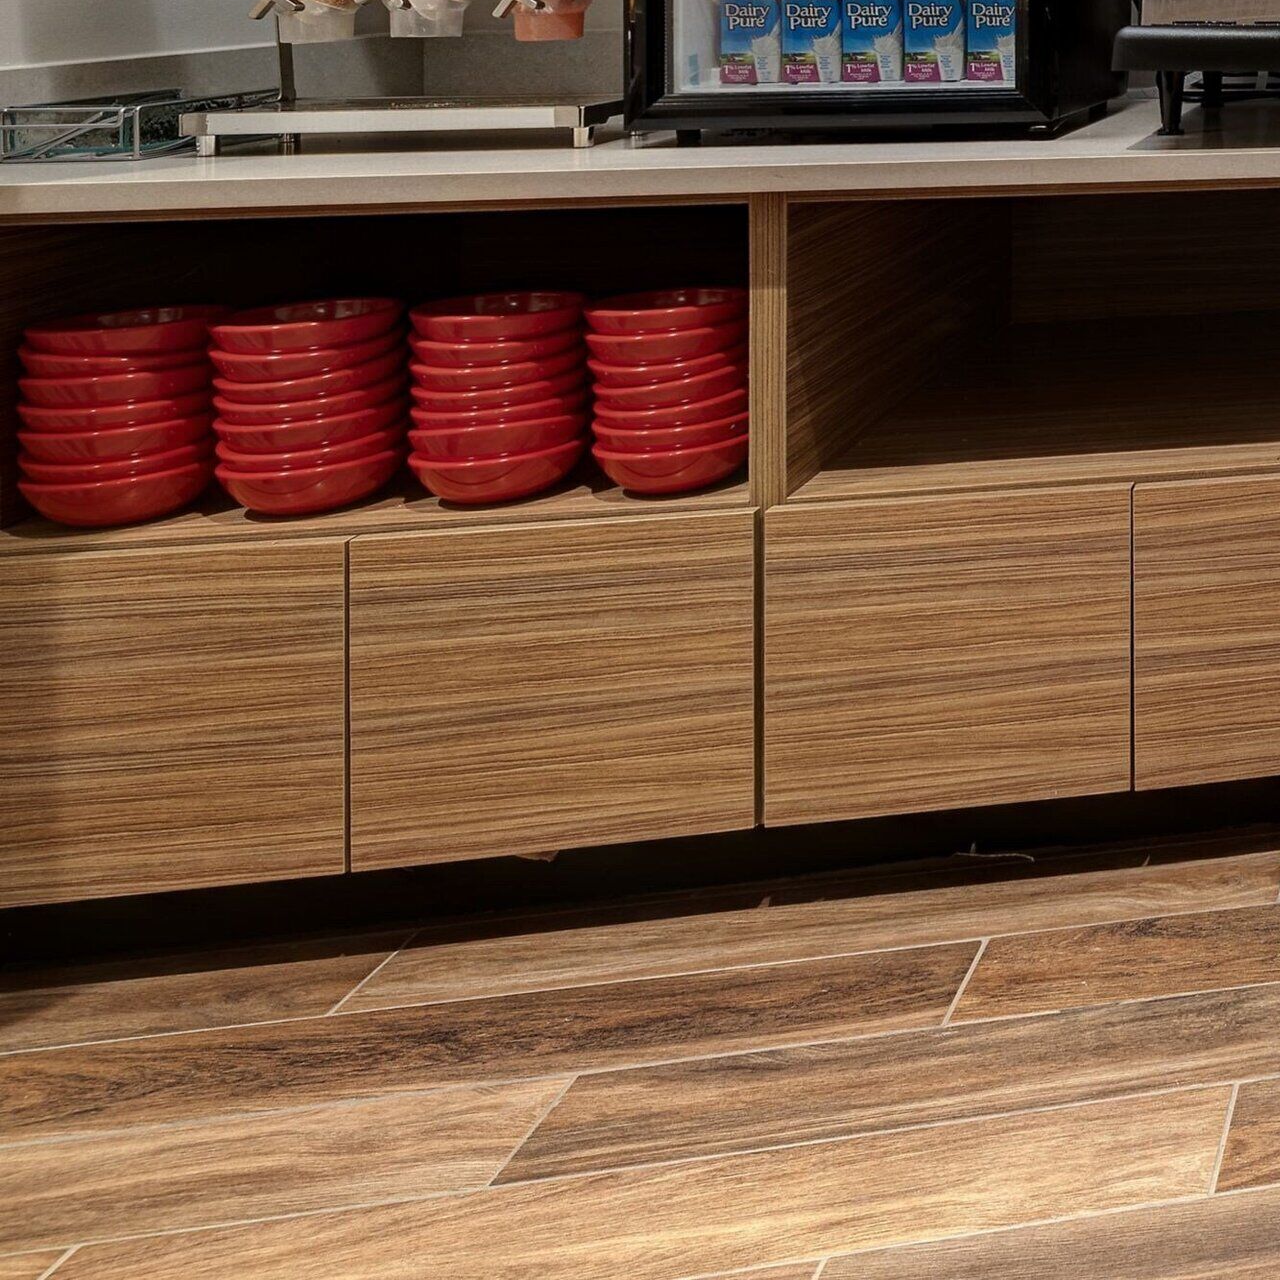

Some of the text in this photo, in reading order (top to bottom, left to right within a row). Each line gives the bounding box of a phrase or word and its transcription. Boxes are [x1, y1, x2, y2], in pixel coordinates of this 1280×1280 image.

[725, 3, 770, 17] Dairy
[786, 3, 831, 18] Dairy
[847, 3, 892, 17] Dairy
[908, 3, 952, 17] Dairy
[972, 3, 1015, 17] Dairy
[729, 17, 765, 29] Pure
[790, 17, 827, 29] Pure
[851, 16, 887, 29] Pure
[912, 16, 948, 29] Pure
[976, 16, 1011, 29] Pure
